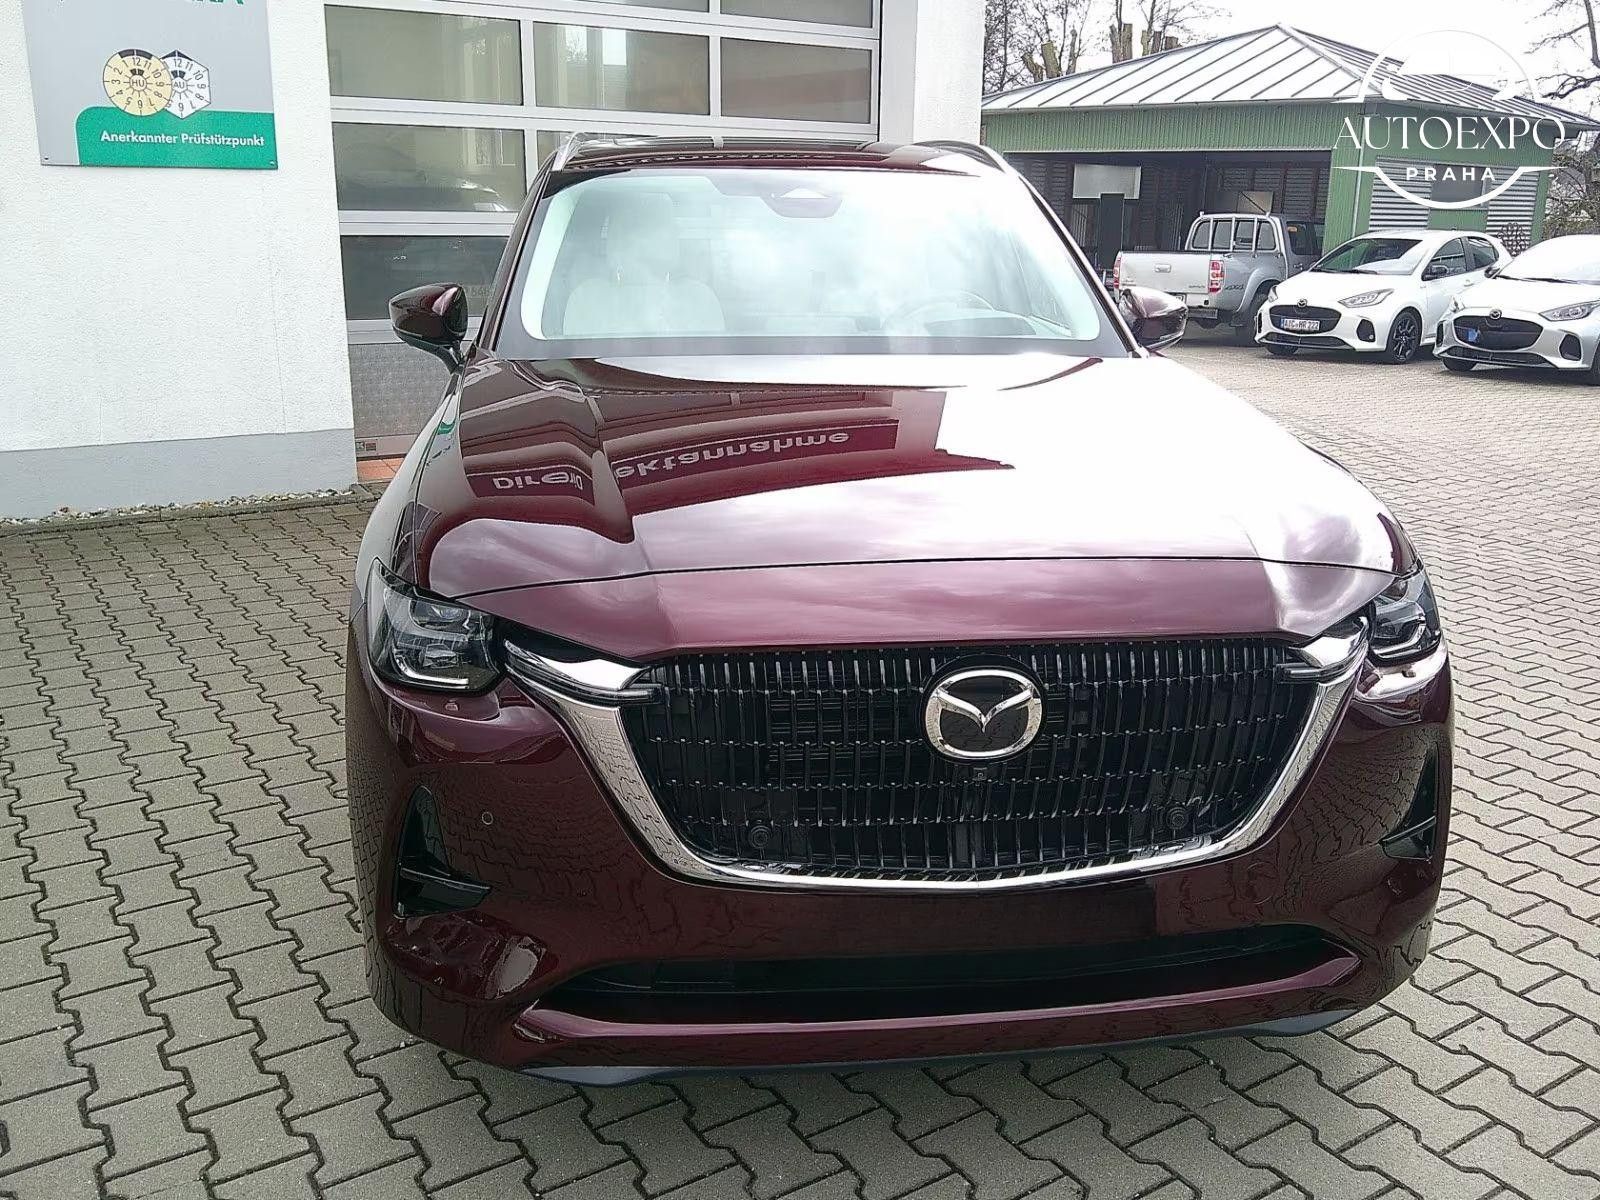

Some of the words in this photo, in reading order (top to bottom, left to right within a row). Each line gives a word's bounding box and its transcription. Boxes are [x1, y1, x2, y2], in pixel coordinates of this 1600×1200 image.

[131, 79, 145, 88] HU
[173, 80, 185, 89] AU
[100, 130, 178, 144] Anerkannter
[180, 132, 265, 148] Prüfstützpunkt
